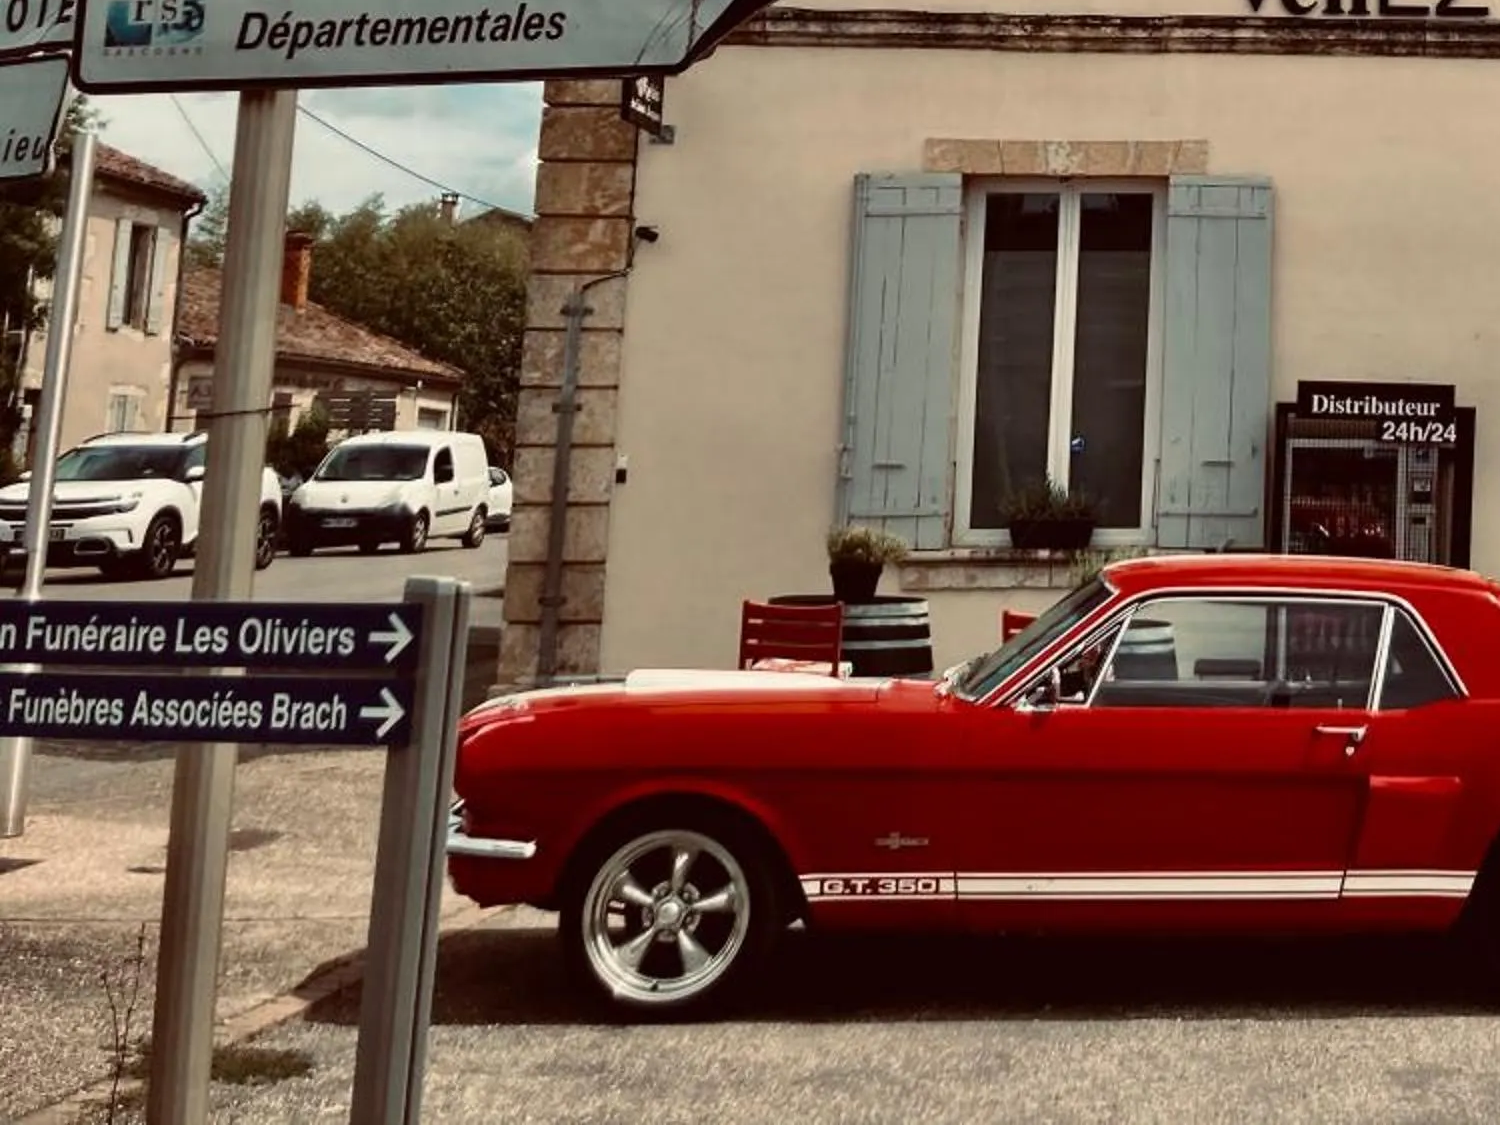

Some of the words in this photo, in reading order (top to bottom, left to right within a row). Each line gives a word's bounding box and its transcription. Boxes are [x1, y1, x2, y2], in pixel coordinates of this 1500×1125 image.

[236, 2, 566, 61] Départementales
[1311, 394, 1441, 417] Distributeur
[1381, 421, 1457, 443] 24h/24
[25, 615, 165, 654] Funéraire
[175, 618, 229, 654] Les
[239, 617, 356, 656] Oliviers
[8, 688, 123, 726] Funèbres
[130, 690, 262, 729] Associées
[271, 693, 347, 731] Brach
[823, 878, 872, 894] G.T.
[877, 878, 937, 894] 350
